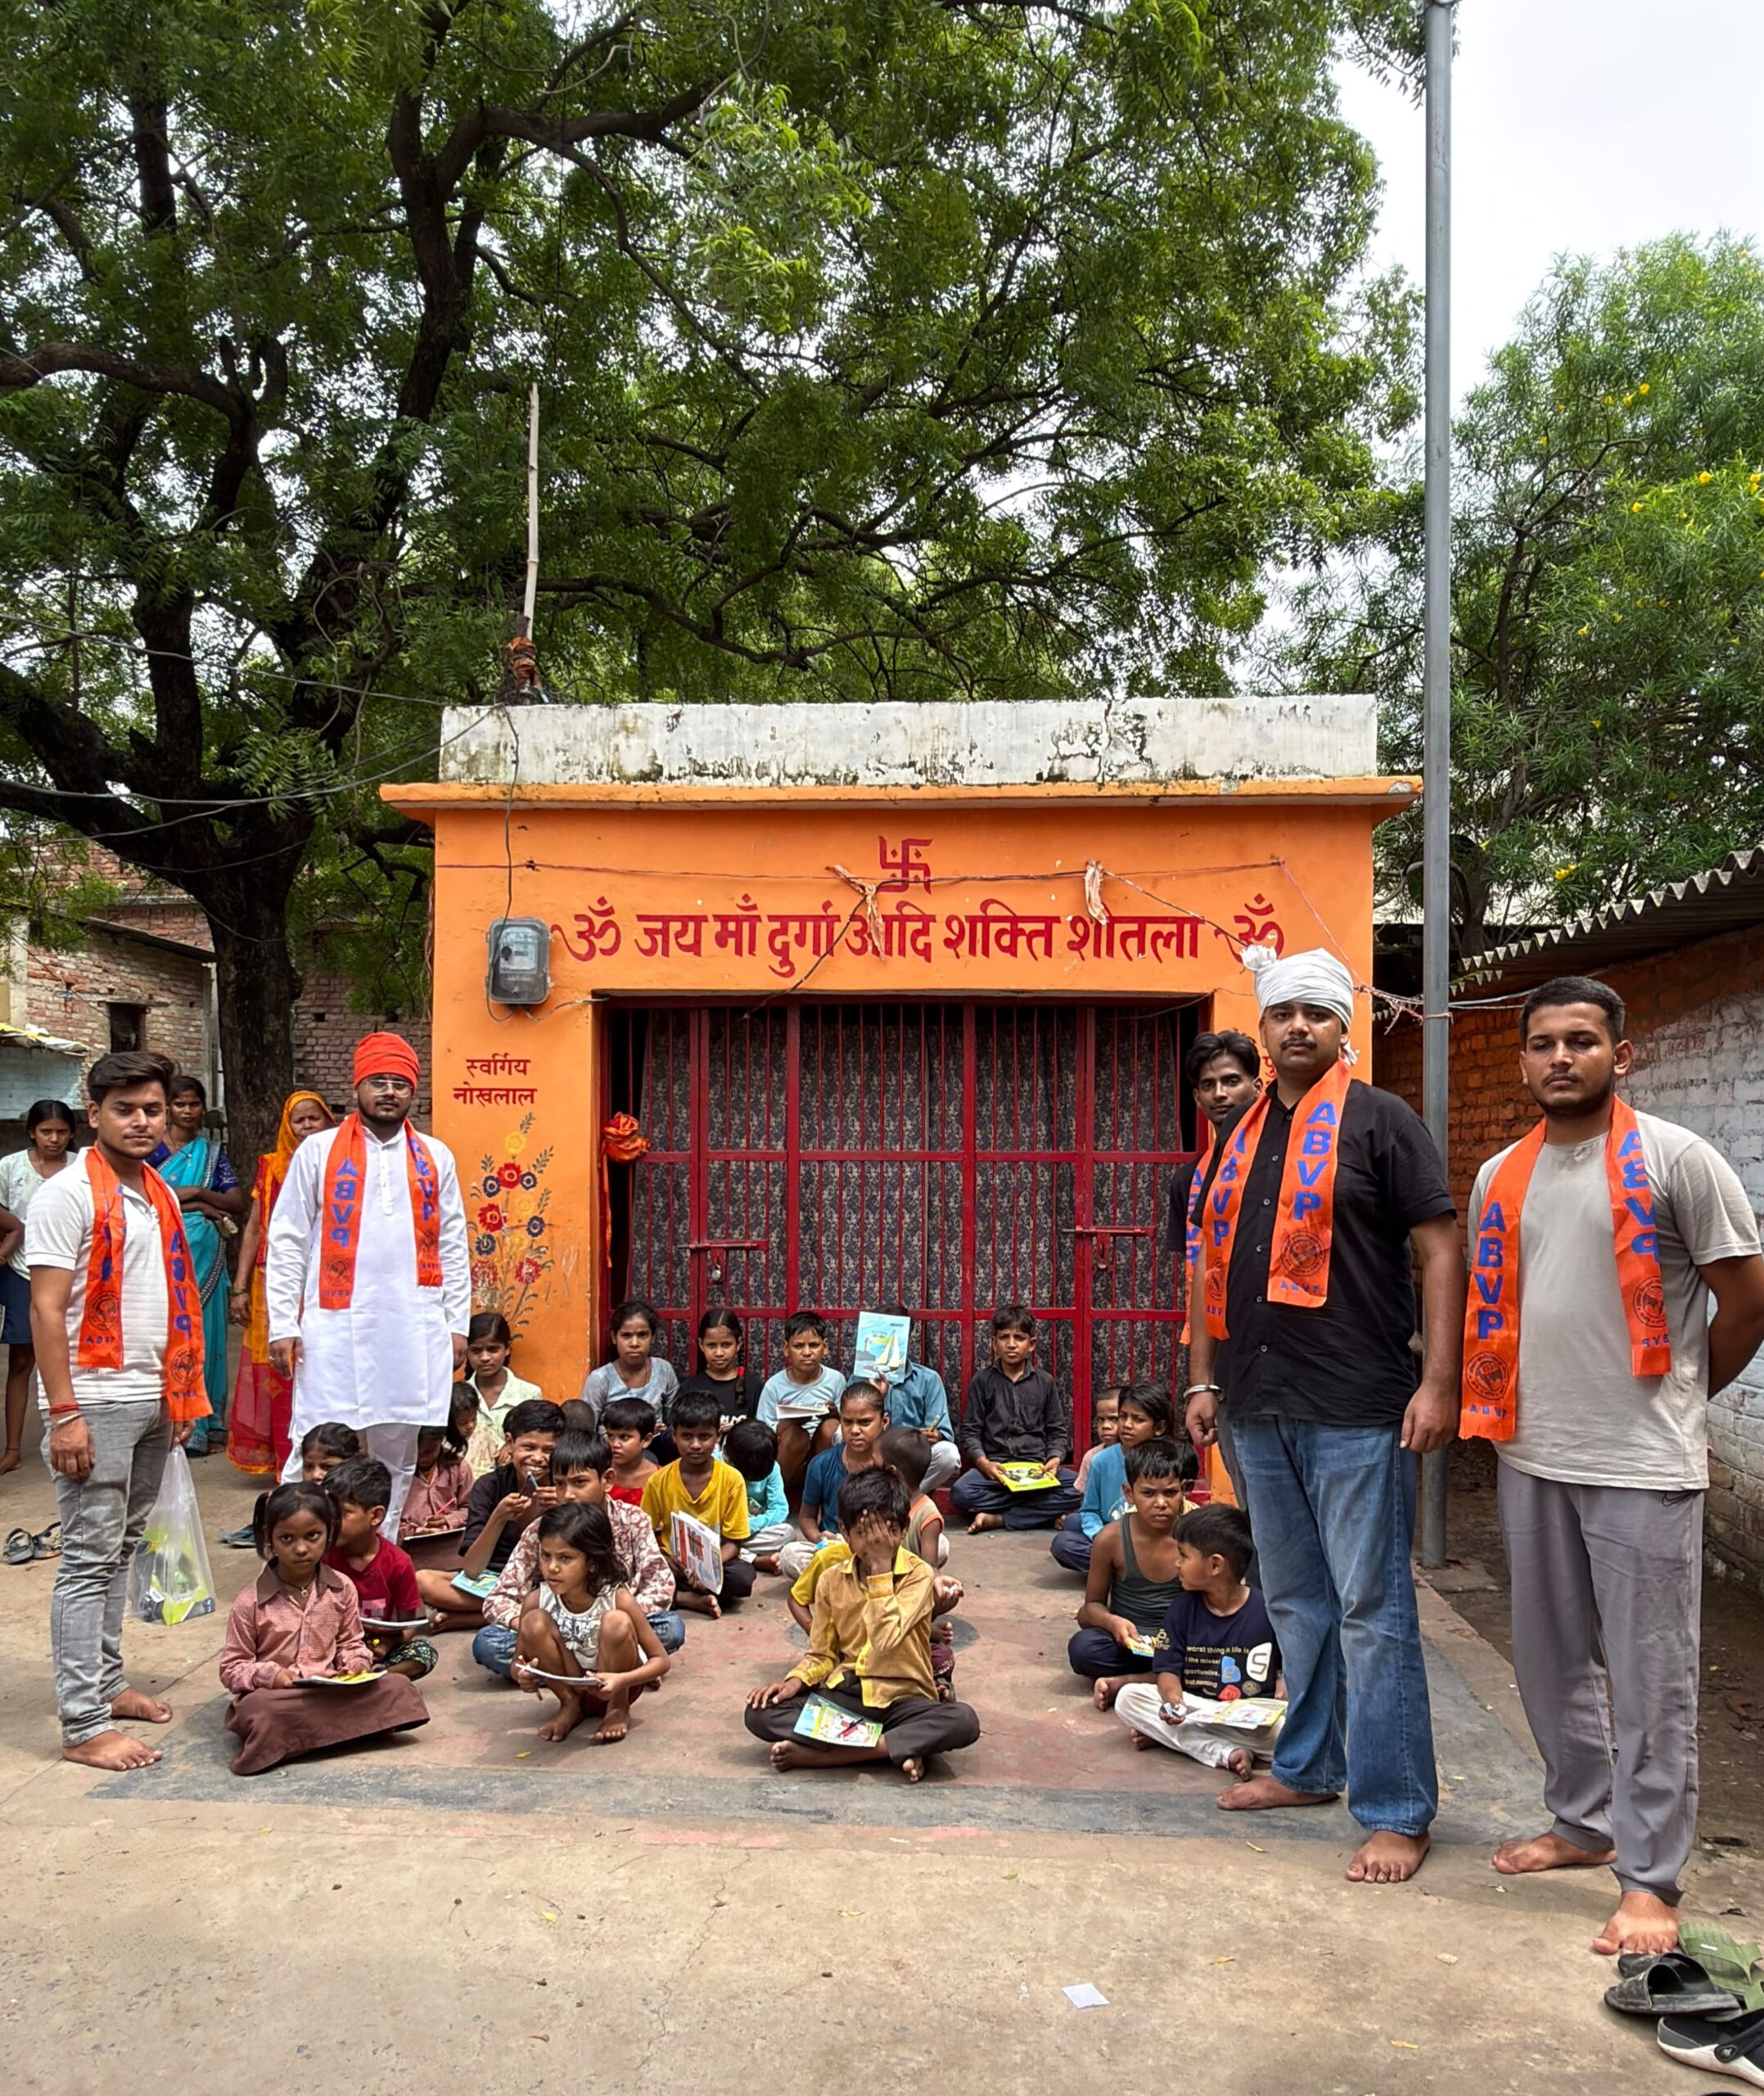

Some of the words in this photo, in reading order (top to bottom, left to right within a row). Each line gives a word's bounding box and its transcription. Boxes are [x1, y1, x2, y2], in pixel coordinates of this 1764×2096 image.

[635, 914, 709, 958] जय
[713, 893, 762, 957] माँ
[767, 900, 841, 978] दुर्गा
[845, 900, 937, 964] आदि
[943, 898, 1062, 961] शक्ति
[1293, 1100, 1338, 1220] ABVP
[1473, 1201, 1506, 1340] ABVP
